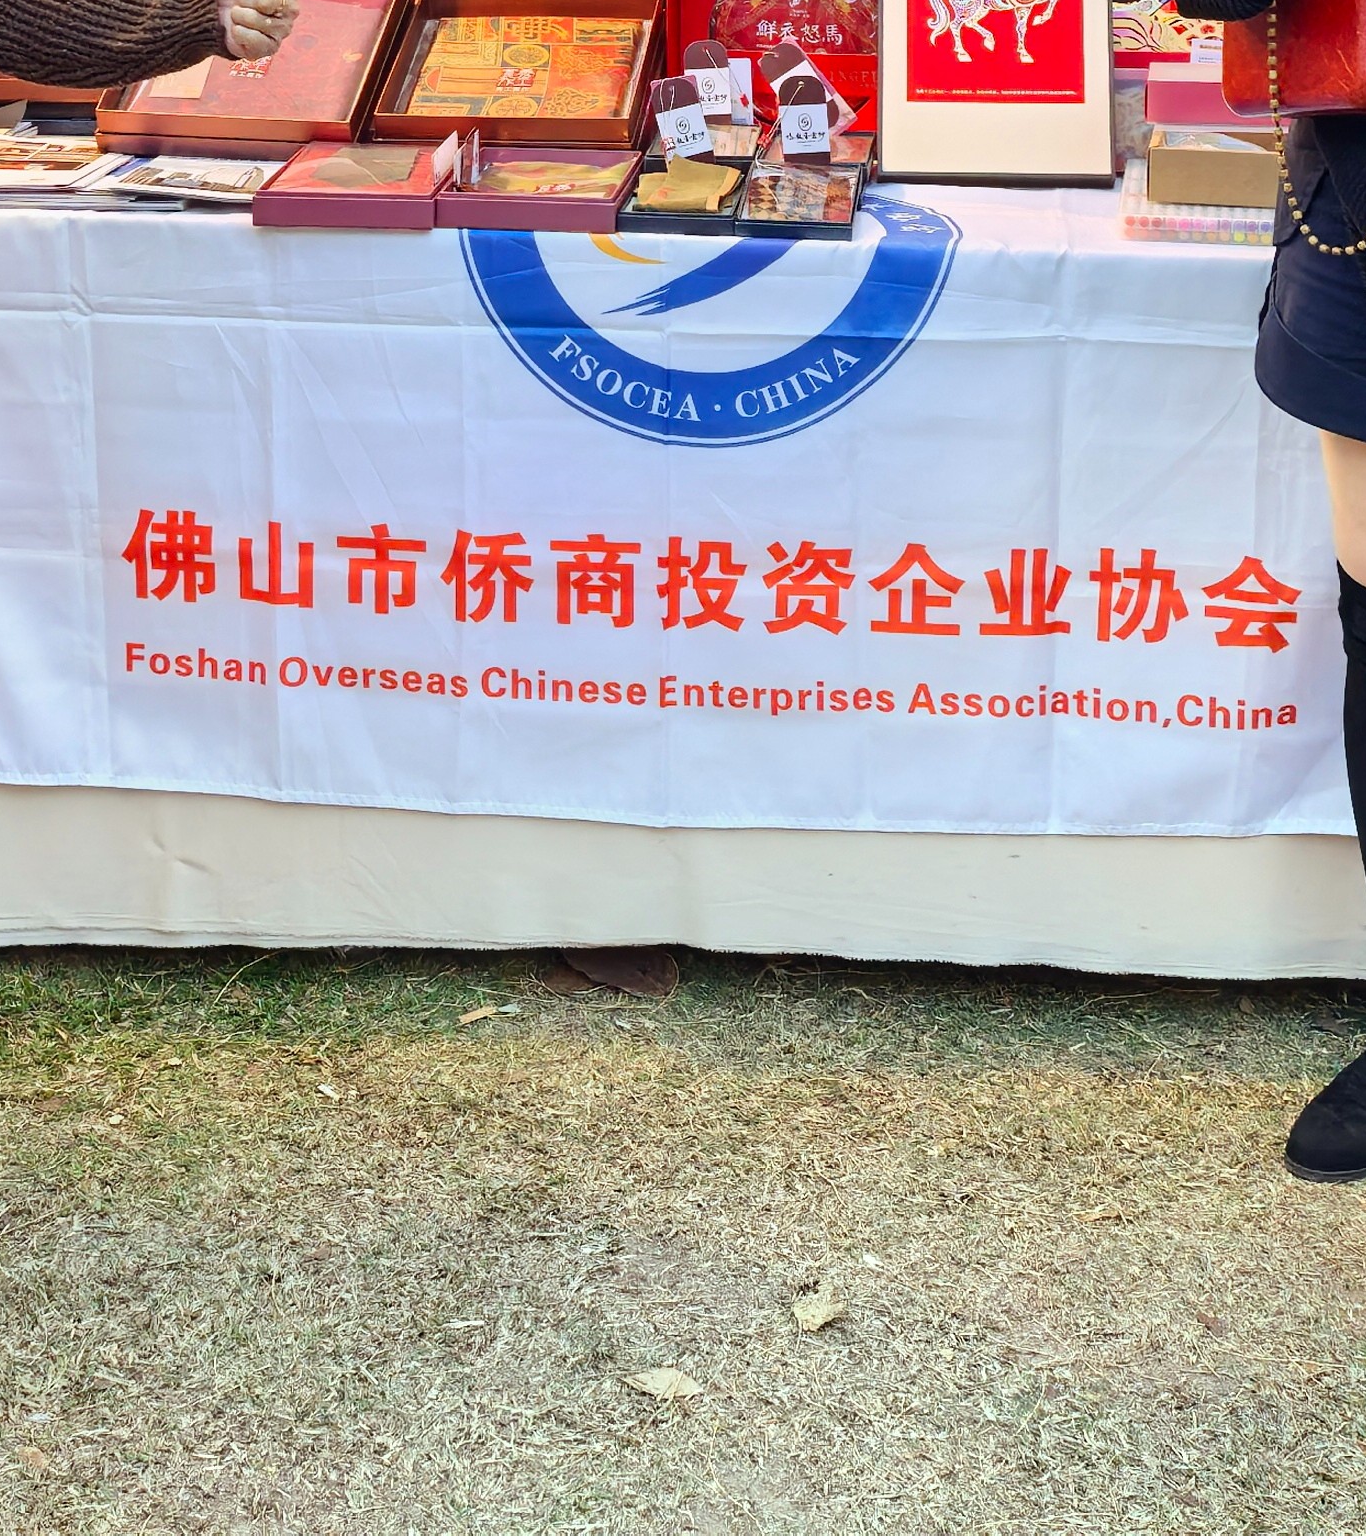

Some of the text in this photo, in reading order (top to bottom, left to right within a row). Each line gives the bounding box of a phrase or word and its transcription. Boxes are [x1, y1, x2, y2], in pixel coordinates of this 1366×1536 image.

[547, 334, 861, 423] FSOCEA CHINA
[122, 509, 1301, 653] 佛山市侨商投资企业协会
[126, 643, 266, 683] Foshan
[279, 658, 467, 697] Overseas
[482, 668, 646, 704] Chinese
[659, 676, 894, 715] Enterprises
